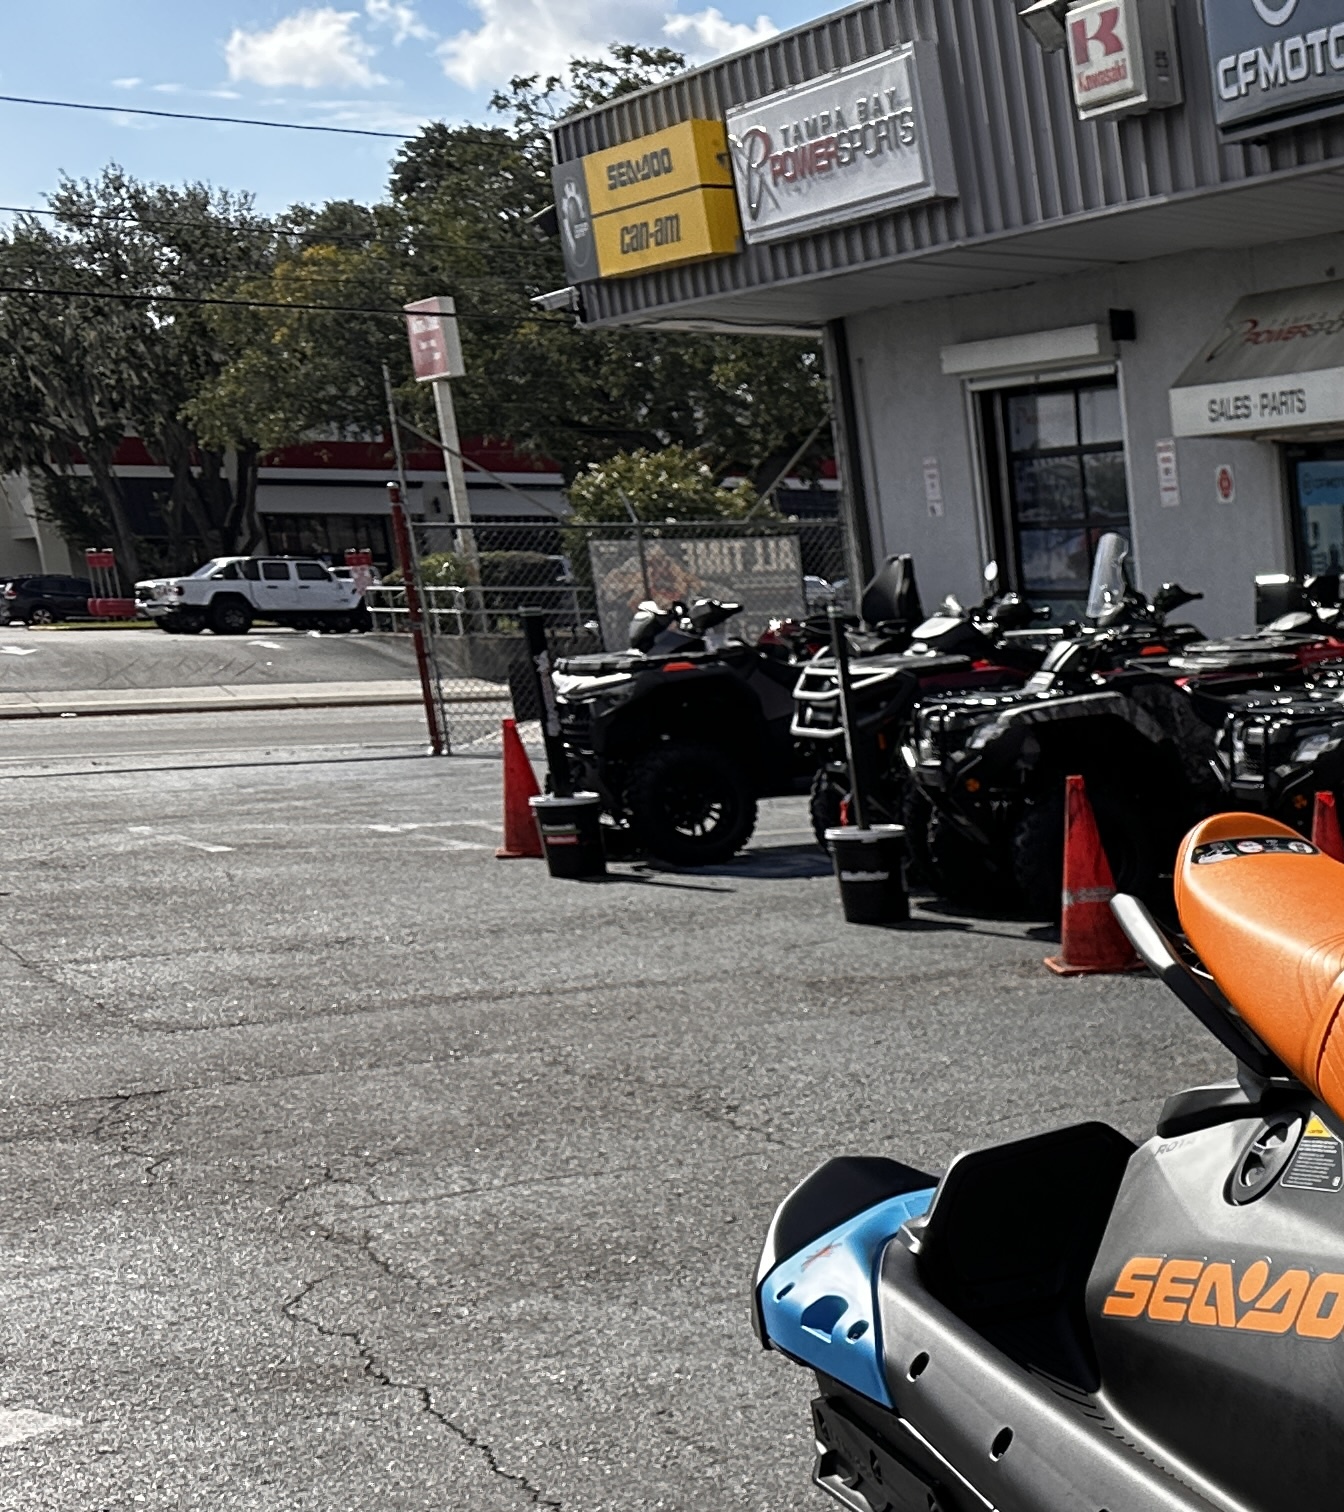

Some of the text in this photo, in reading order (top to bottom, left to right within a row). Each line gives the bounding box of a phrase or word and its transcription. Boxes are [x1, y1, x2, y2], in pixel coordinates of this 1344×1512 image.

[1077, 59, 1129, 93] Kawasaki
[779, 87, 896, 148] TAMPA BAY
[769, 106, 915, 187] POWERSPORTS
[1207, 388, 1307, 423] SALES PARTS
